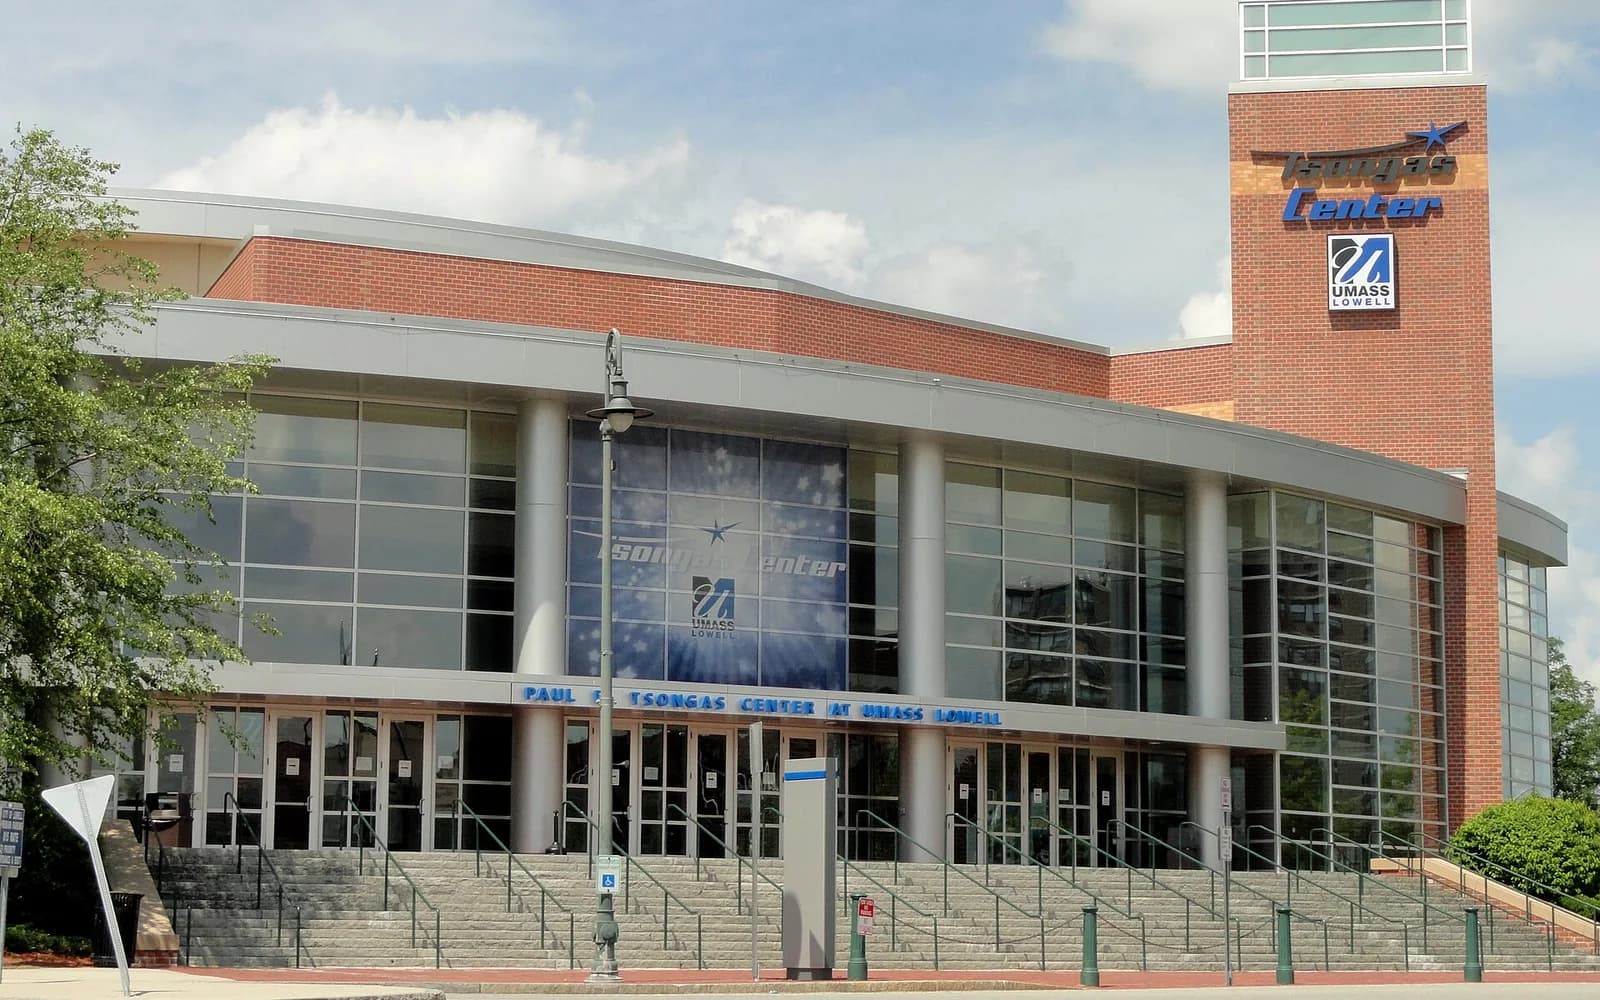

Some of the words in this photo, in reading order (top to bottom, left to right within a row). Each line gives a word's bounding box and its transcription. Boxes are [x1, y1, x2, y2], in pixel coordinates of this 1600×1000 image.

[1279, 151, 1457, 184] Tsongas
[1282, 187, 1442, 221] Center
[1331, 285, 1390, 297] UMASS
[1332, 298, 1391, 307] LOWELL
[692, 618, 735, 631] UMASS
[691, 629, 736, 640] LOWELL
[523, 687, 575, 703] PAUL
[630, 691, 726, 711] TSONGAS
[739, 697, 816, 715] CENTER
[829, 703, 851, 717] AT
[861, 704, 924, 721] UMASS
[934, 709, 1002, 726] LOWELL
